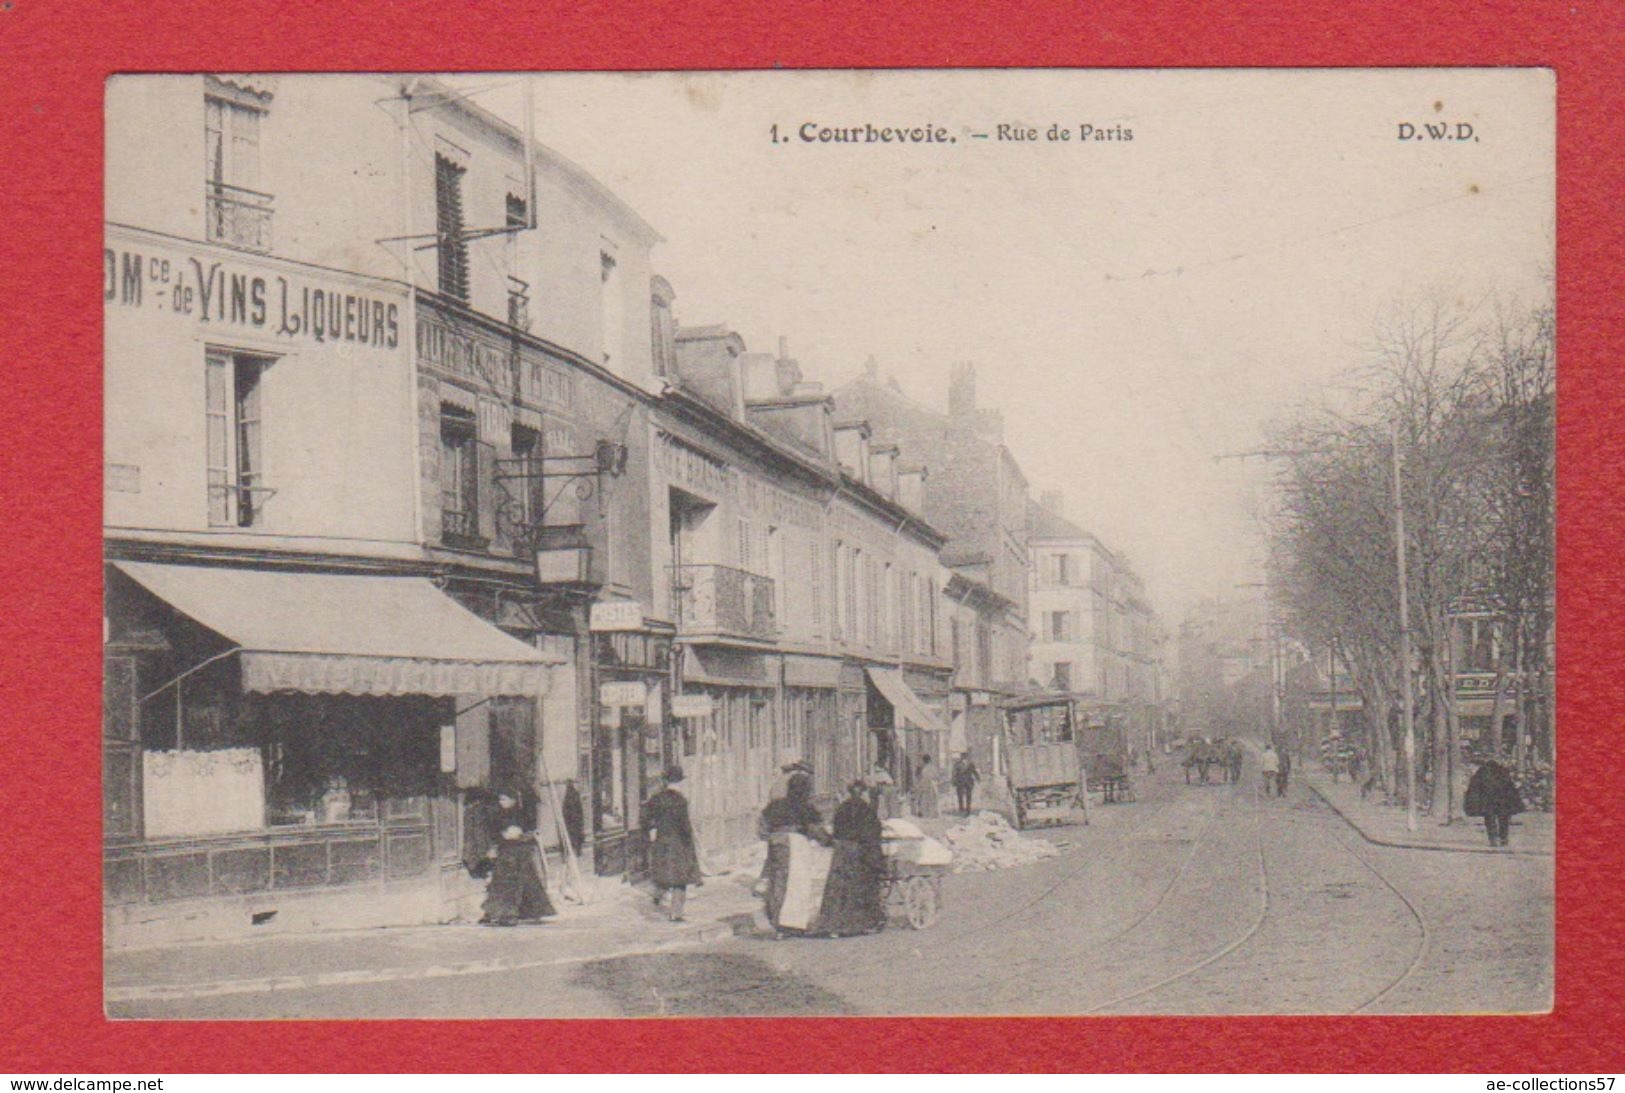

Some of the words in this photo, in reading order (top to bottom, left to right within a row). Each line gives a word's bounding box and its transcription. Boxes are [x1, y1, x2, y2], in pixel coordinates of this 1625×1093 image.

[172, 272, 193, 314] de
[189, 256, 267, 325] VINS
[276, 276, 399, 350] LIQUEURS
